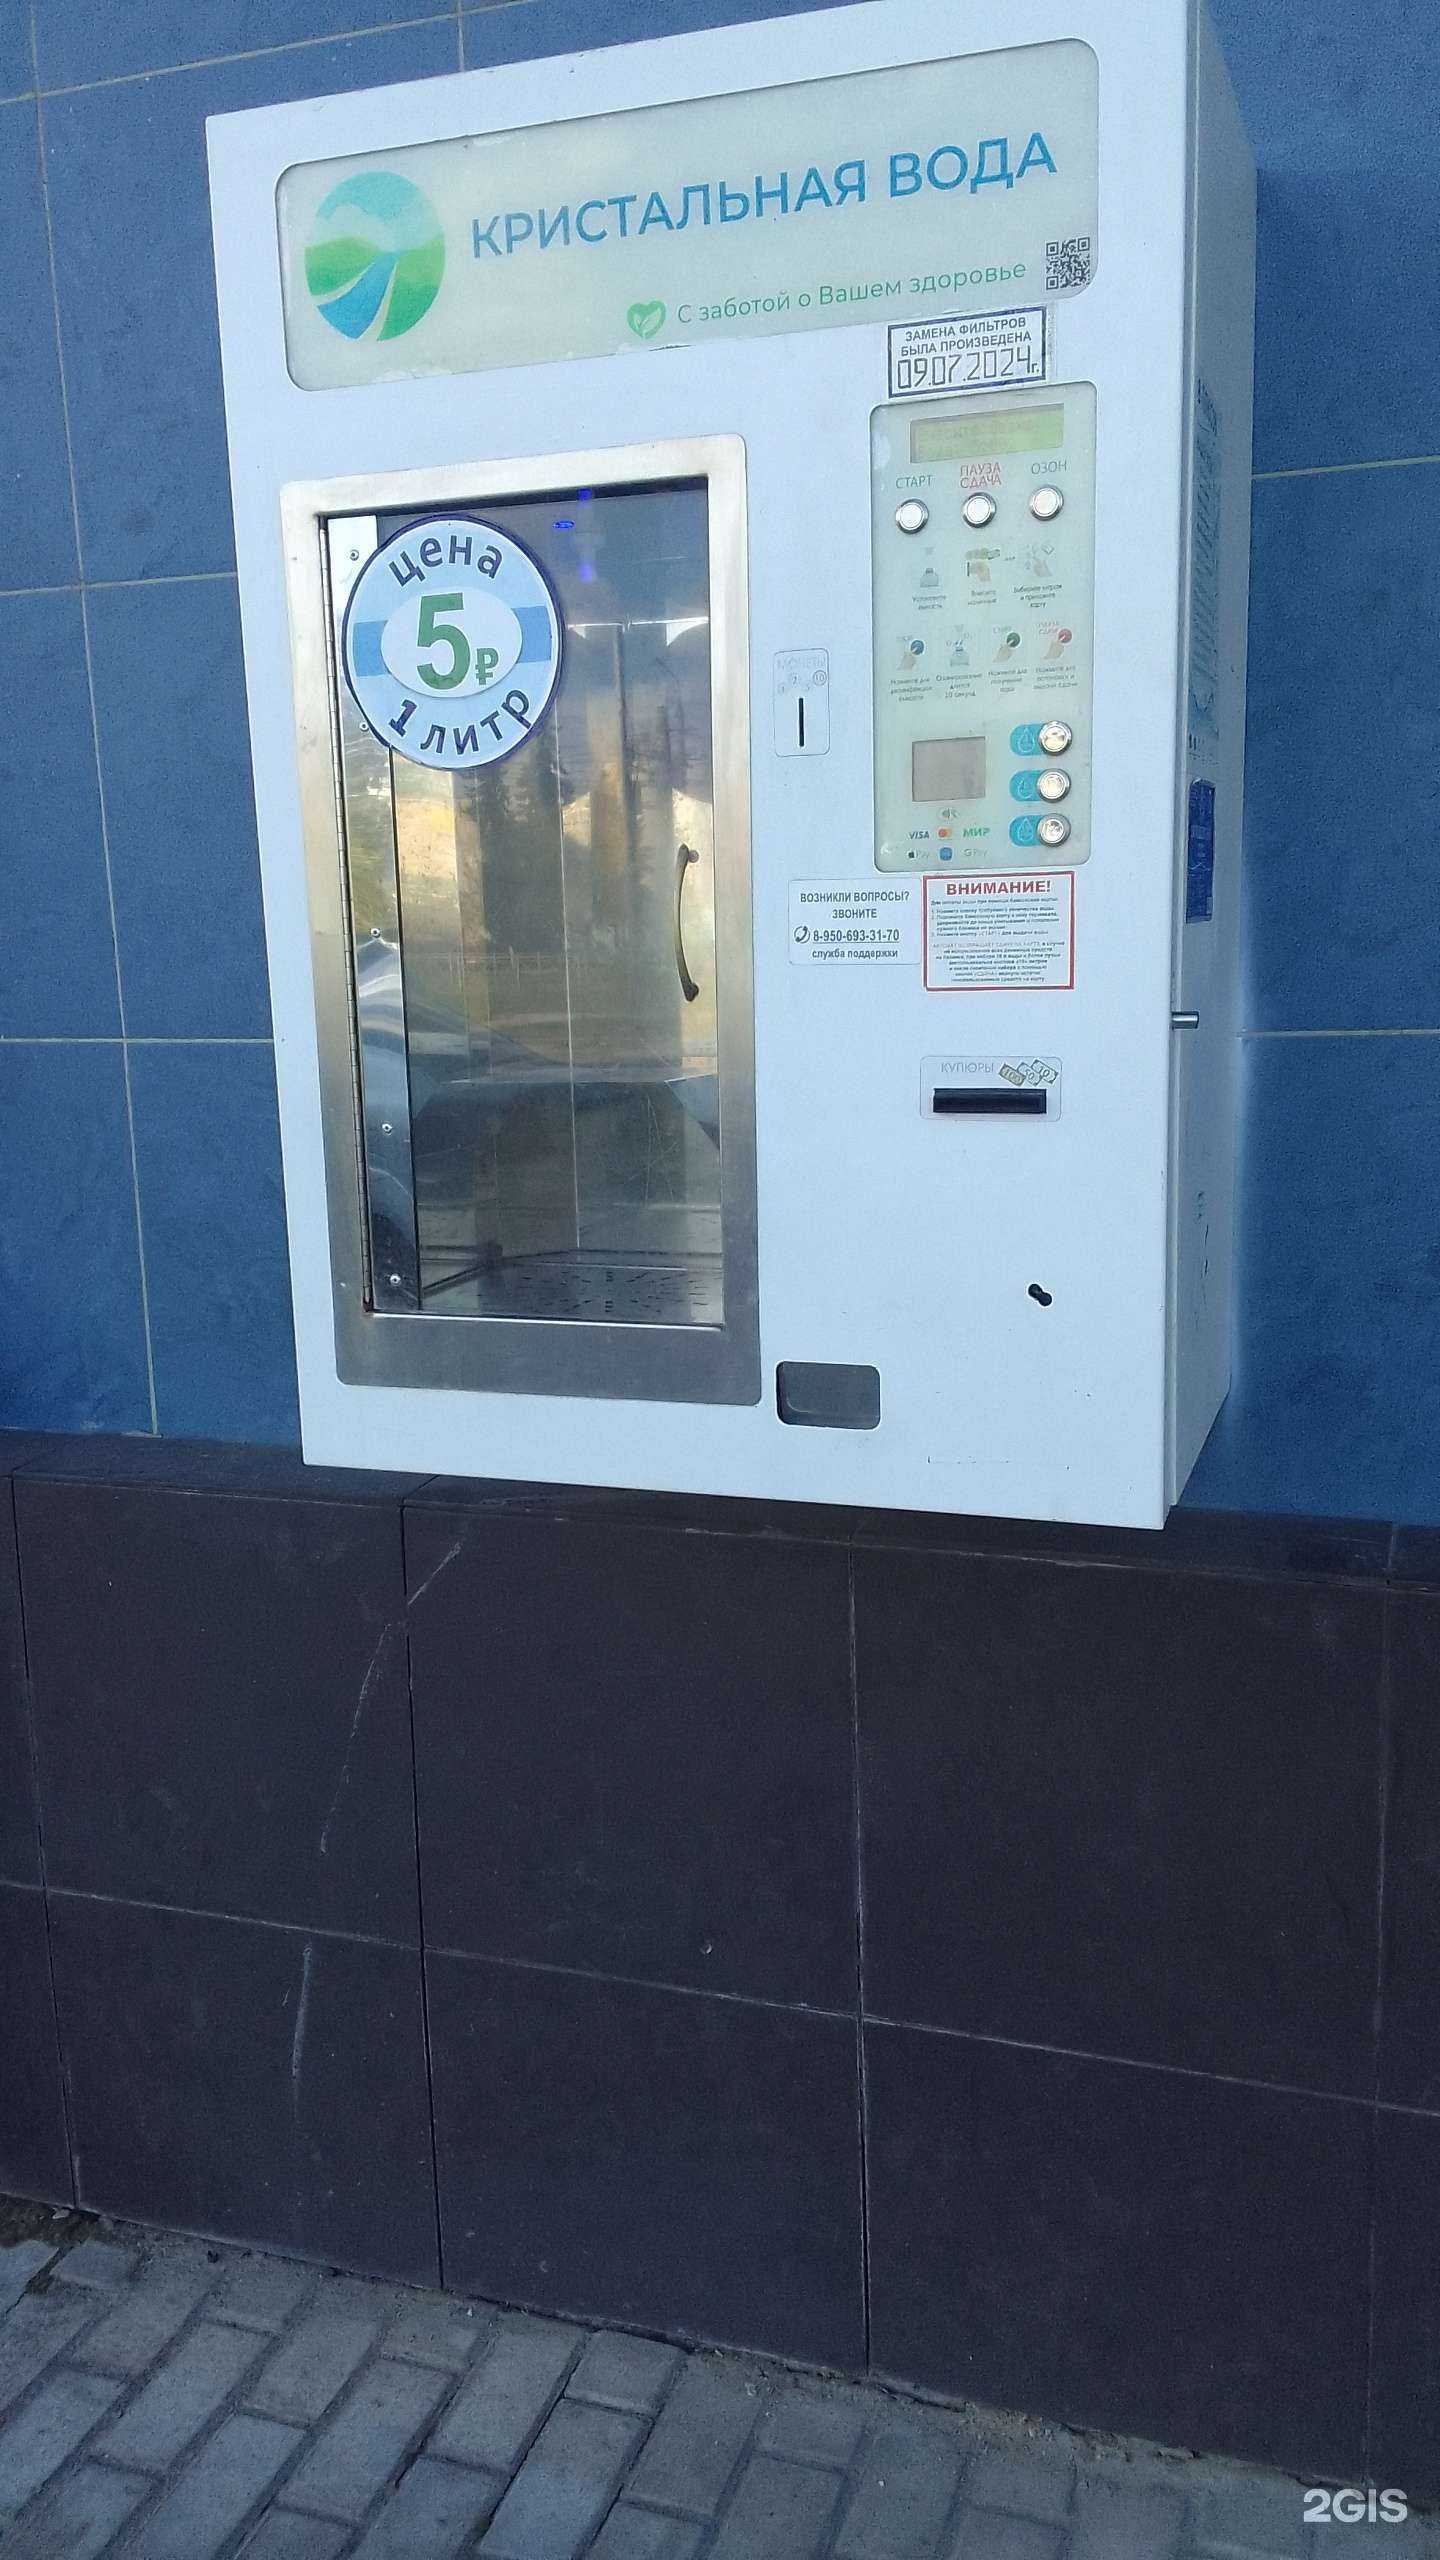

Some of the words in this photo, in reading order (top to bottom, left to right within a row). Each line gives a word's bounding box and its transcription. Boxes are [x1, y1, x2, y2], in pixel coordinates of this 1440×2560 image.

[472, 160, 866, 259] КРИСТАЛЬНАЯ
[889, 132, 1058, 198] ВОДА
[678, 303, 691, 323] С
[699, 291, 790, 321] заботой
[799, 292, 811, 307] о
[820, 278, 901, 305] Вашем
[909, 263, 1026, 296] здоровье
[905, 326, 956, 342] ЗАМЕНА
[959, 316, 1026, 335] ФИЛЬТРОВ
[901, 342, 937, 356] БЫЛА
[941, 331, 1032, 352] ПРОИЗВЕДЕНА
[960, 462, 1001, 476] ПАУЗА
[1031, 461, 1067, 475] ОЗОН
[896, 475, 933, 489] СТАРТ
[960, 475, 1002, 489] СДАЧА
[388, 535, 503, 587] цена
[388, 698, 418, 737] 1
[420, 689, 532, 755] литр
[909, 830, 930, 840] VISA
[962, 828, 990, 840] МИР
[946, 880, 1051, 895] ВНИМАНИЕ!
[800, 892, 851, 903] ВОЗНИКЛИ
[854, 891, 910, 902] ВОПРОСЫ?
[832, 908, 878, 919] ЗВОНИТЕ
[813, 929, 900, 942] 8-950-693-31-70
[812, 948, 845, 960] служба
[847, 948, 898, 960] поддержки
[941, 1062, 994, 1073] КУПЮРЫ
